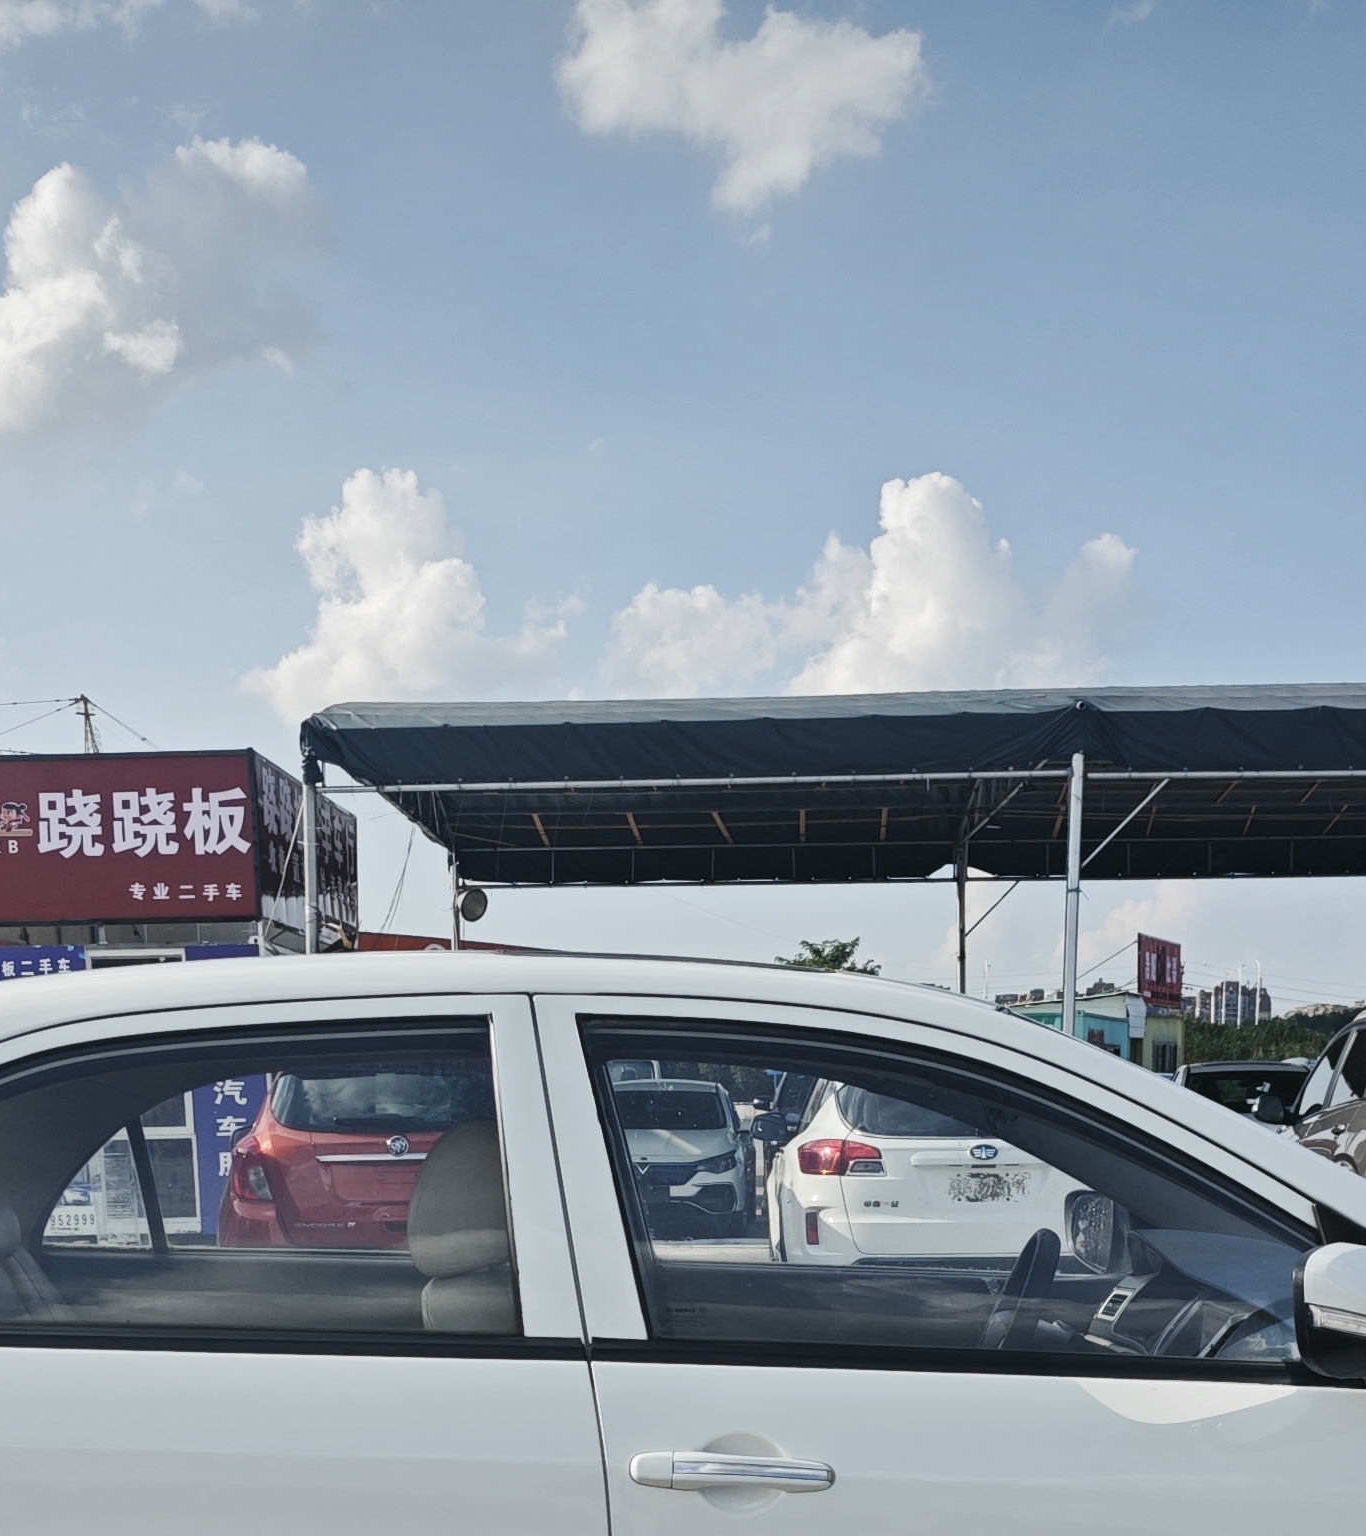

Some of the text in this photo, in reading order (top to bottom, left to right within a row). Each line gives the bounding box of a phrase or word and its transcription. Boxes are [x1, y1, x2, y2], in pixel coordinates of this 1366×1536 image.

[37, 786, 252, 859] 跷跷板
[128, 882, 243, 902] 专业二手车
